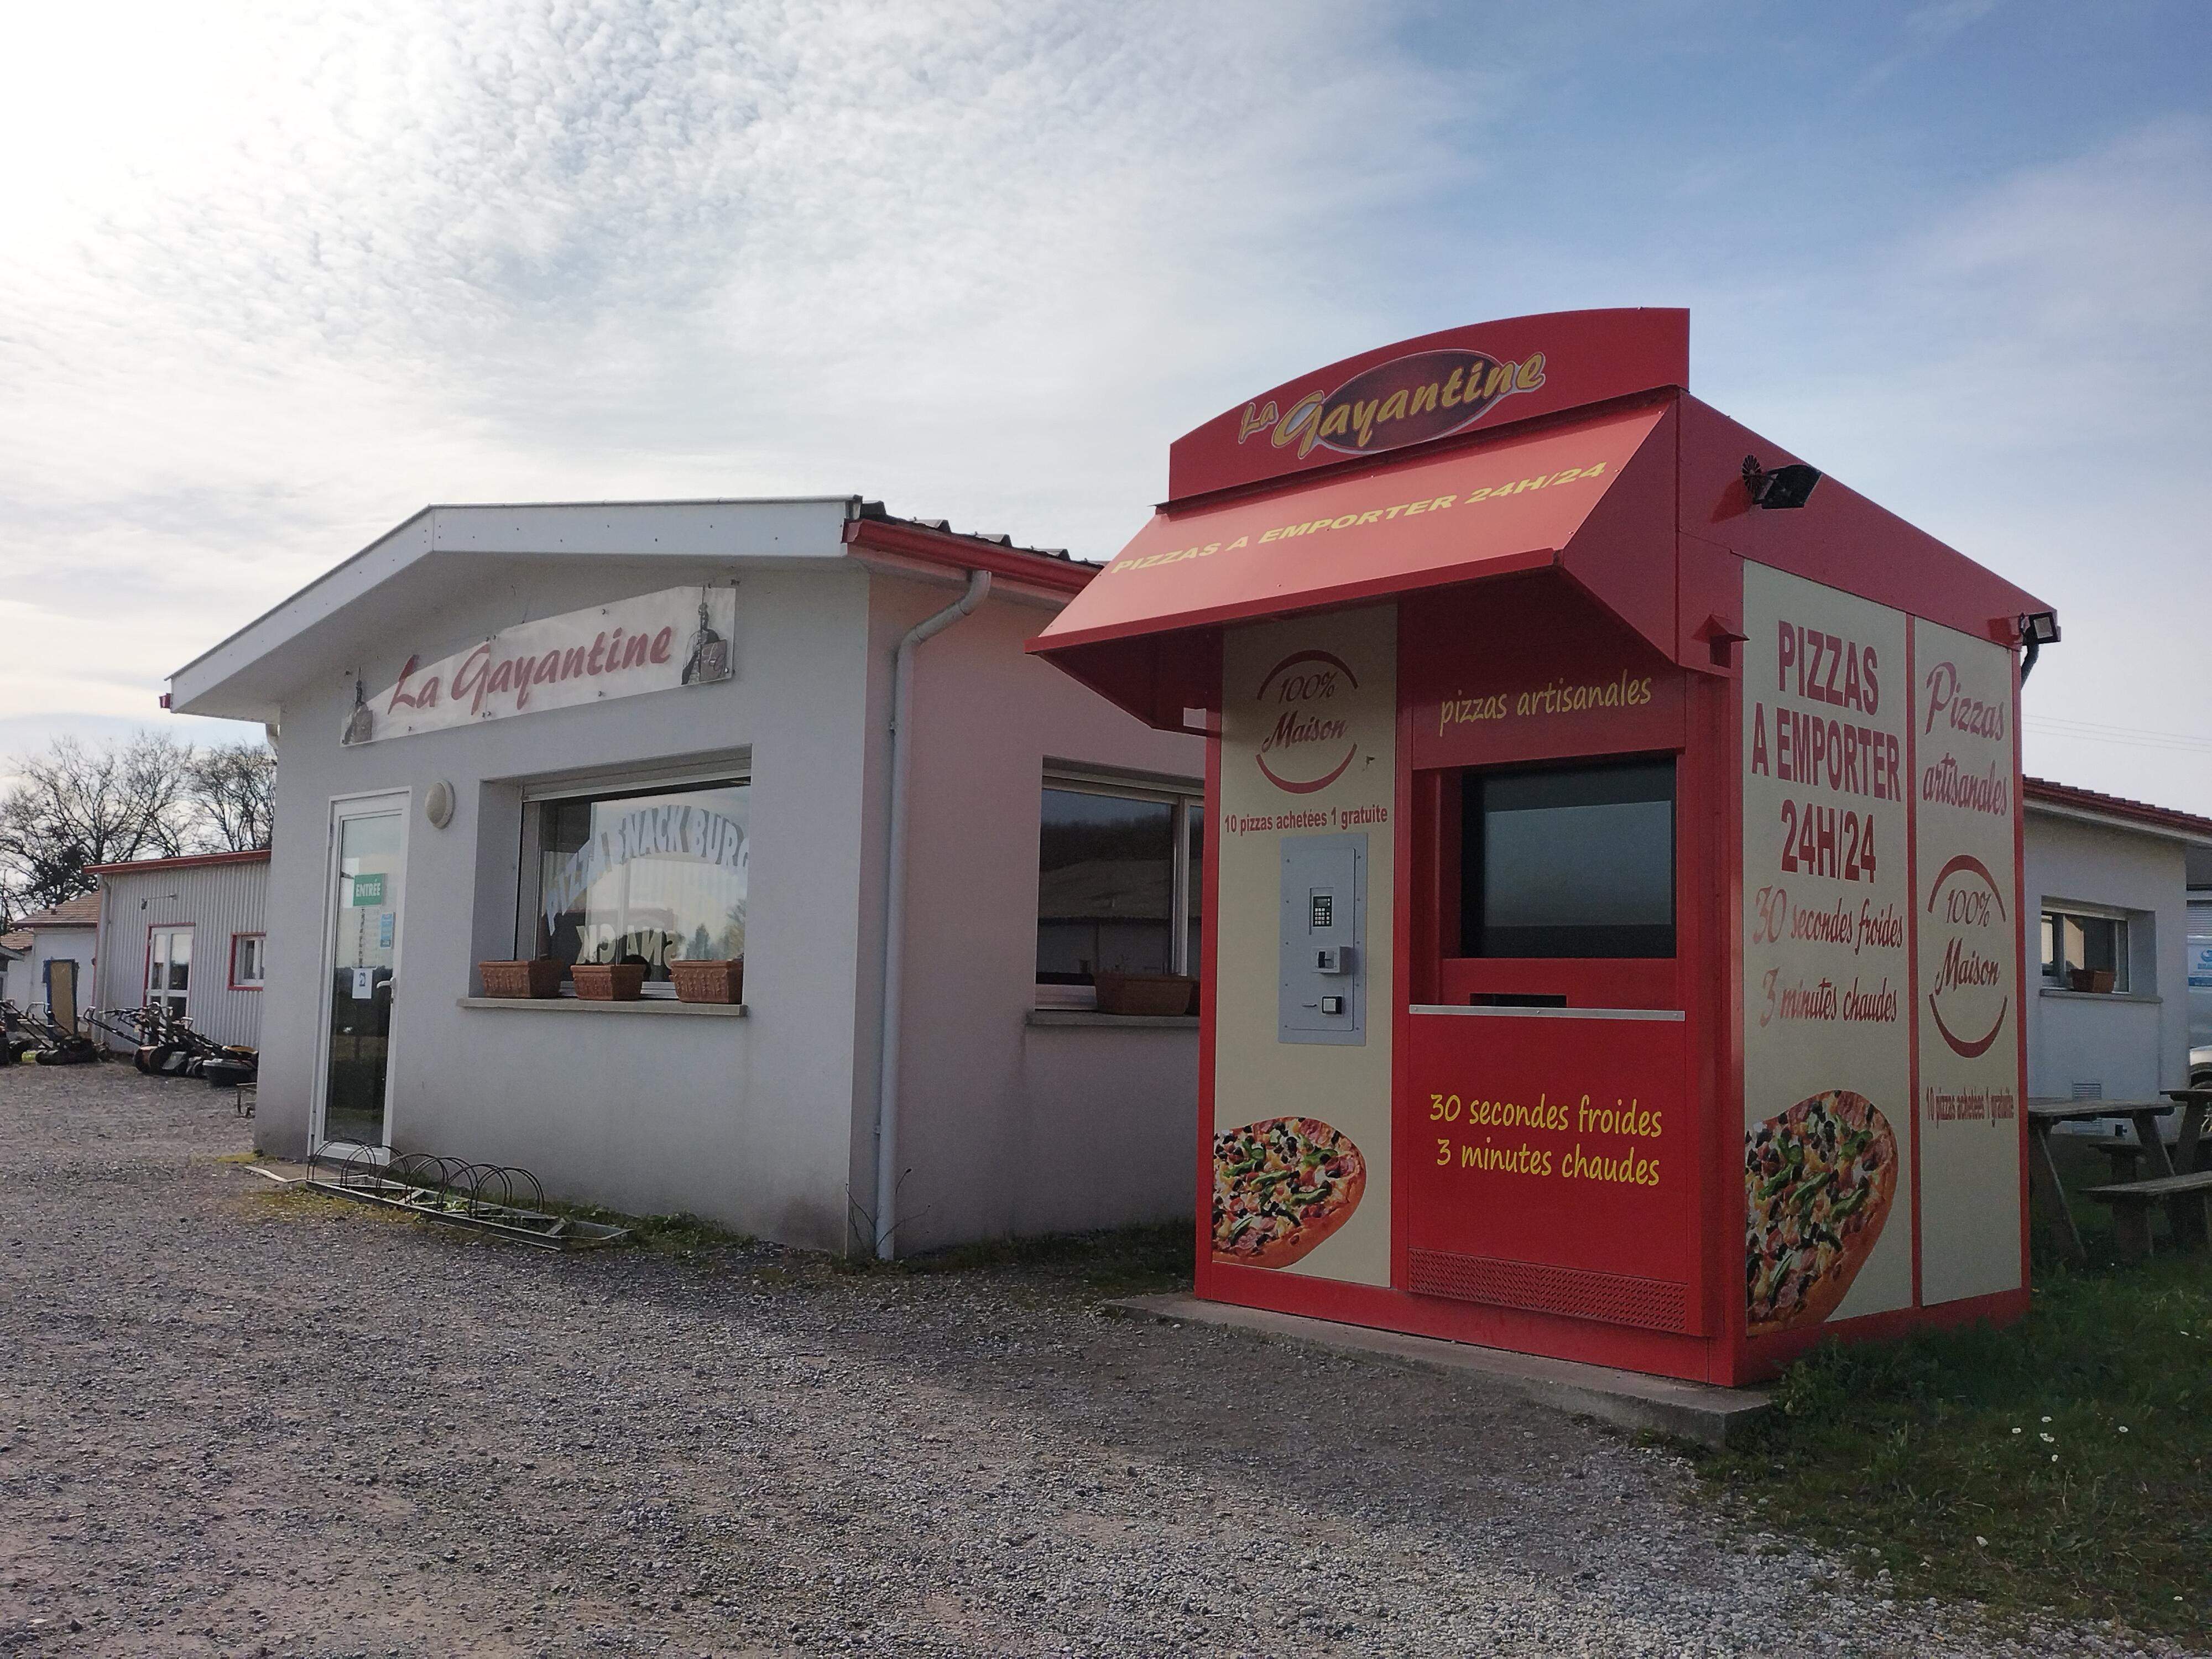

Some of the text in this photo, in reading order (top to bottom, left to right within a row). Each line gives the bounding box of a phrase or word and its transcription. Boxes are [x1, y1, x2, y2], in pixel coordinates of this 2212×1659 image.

[1239, 352, 1546, 458] La Gayantine
[1110, 462, 1606, 573] PIZZAS A EMPORTER 24H/24
[388, 625, 672, 716] La Gayantine
[1279, 672, 1337, 704] 100%
[1778, 619, 1879, 716] PIZZAS
[1261, 711, 1347, 753] Maison
[1439, 669, 1652, 738] pizzas artisanales
[1924, 661, 2005, 741] Pizzas
[1752, 702, 1901, 802] A EMPORTER
[1923, 752, 2007, 817] artisanales
[610, 805, 691, 865] SNACK
[1225, 804, 1388, 836] 10 pizzas achetées 1 gratuite
[1781, 799, 1876, 883] 24H/24
[356, 879, 380, 897] ENTRÉE
[1945, 889, 1991, 927] 100%
[1752, 885, 1903, 955] 30 secondes froides
[1760, 966, 1897, 1027] 3 minutes chaudes
[1936, 936, 2000, 995] Maison
[1430, 1093, 1662, 1138] 30 secondes froides
[1437, 1137, 1660, 1186] 3 minutes chaudes
